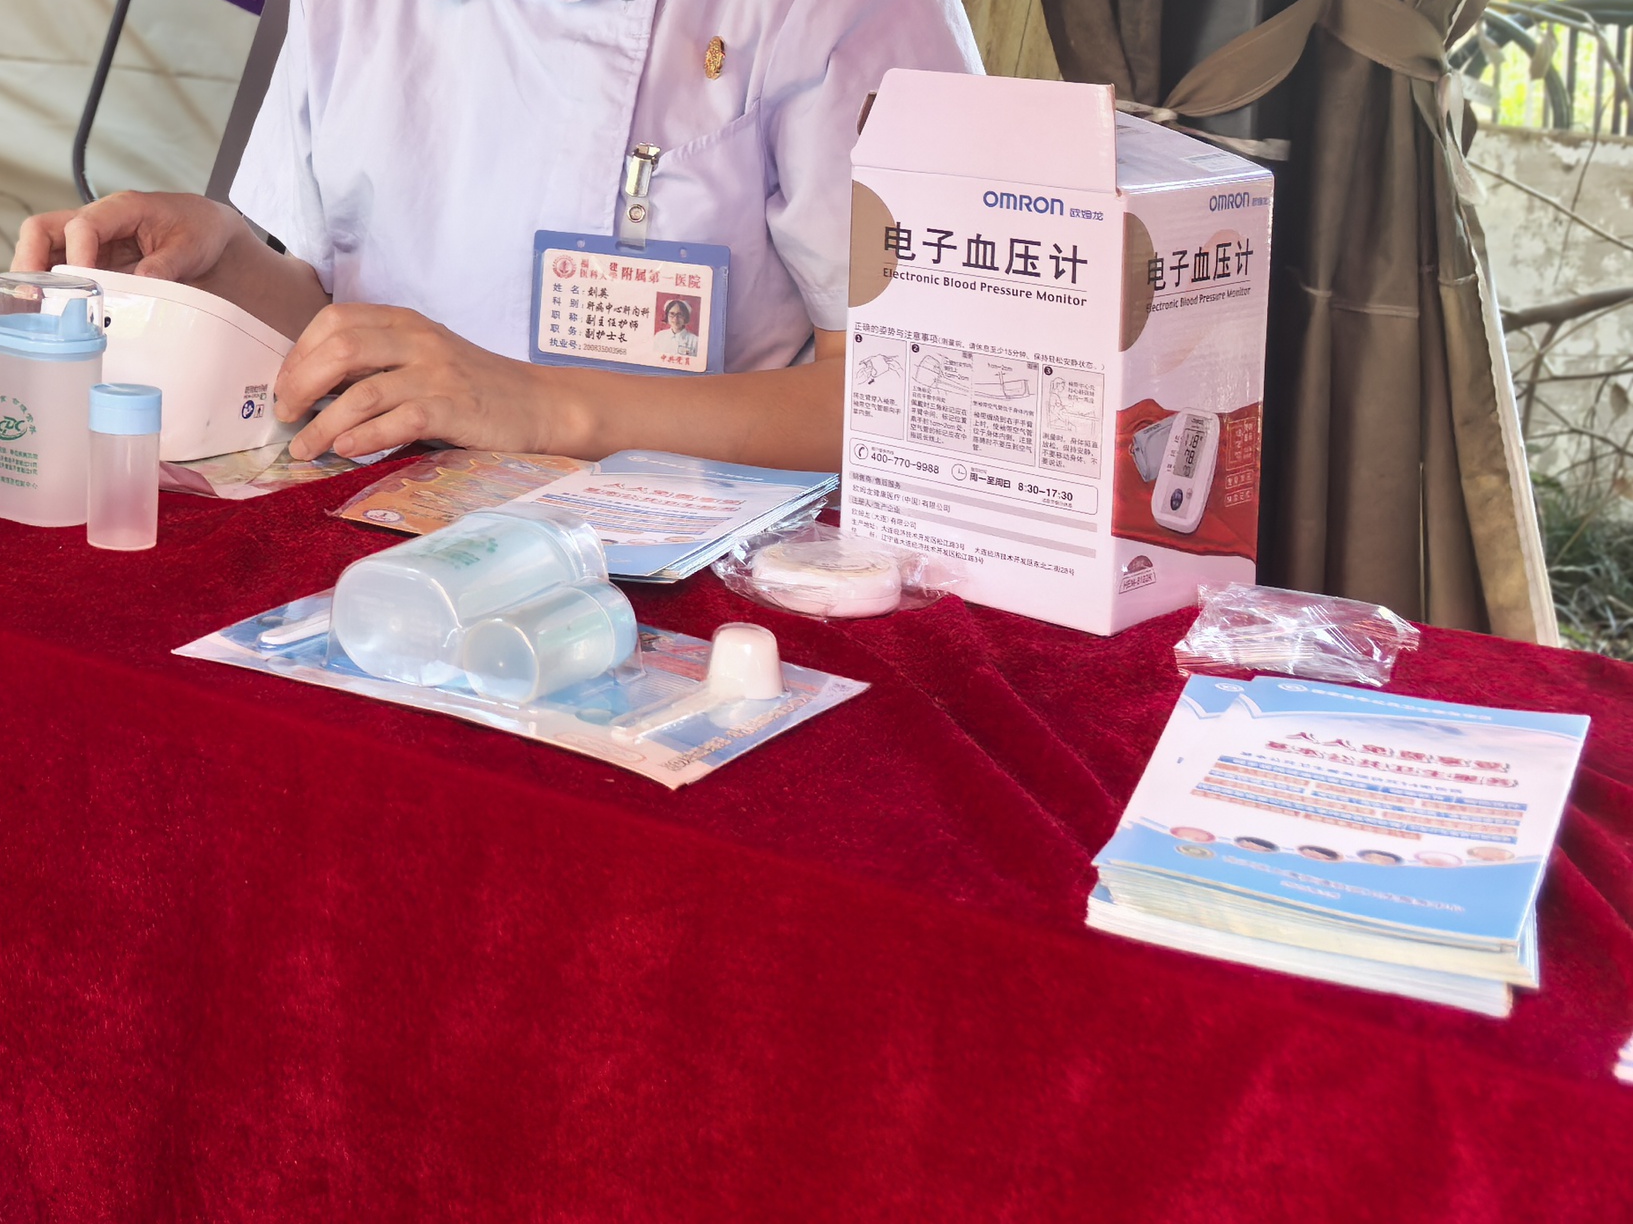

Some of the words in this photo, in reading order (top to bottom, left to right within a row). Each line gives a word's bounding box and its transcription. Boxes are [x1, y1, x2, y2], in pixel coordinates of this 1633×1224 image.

[983, 190, 1064, 216] OMRON
[1069, 207, 1104, 221] 欧姆龙
[1209, 191, 1251, 212] OMRON
[884, 221, 1088, 284] 电子血压计
[1147, 238, 1254, 292] 电子血压计
[621, 266, 702, 289] 附属第一医院
[883, 267, 940, 286] Electronic
[943, 277, 977, 291] Blood
[980, 282, 1033, 299] Pressure
[1036, 289, 1088, 307] Monitor
[587, 286, 609, 299] 刘英
[1146, 299, 1179, 313] Electronic
[1180, 296, 1198, 307] Blood
[1199, 291, 1226, 304] Pressure
[1227, 286, 1252, 298] Monitor
[586, 301, 650, 319] 肝病中心肝内科
[586, 314, 639, 331] 副主任护师
[585, 328, 628, 343] 副护士长
[660, 353, 691, 366] 中共党员
[871, 452, 940, 475] 400-770-9988
[969, 472, 1011, 489] 周一至周日
